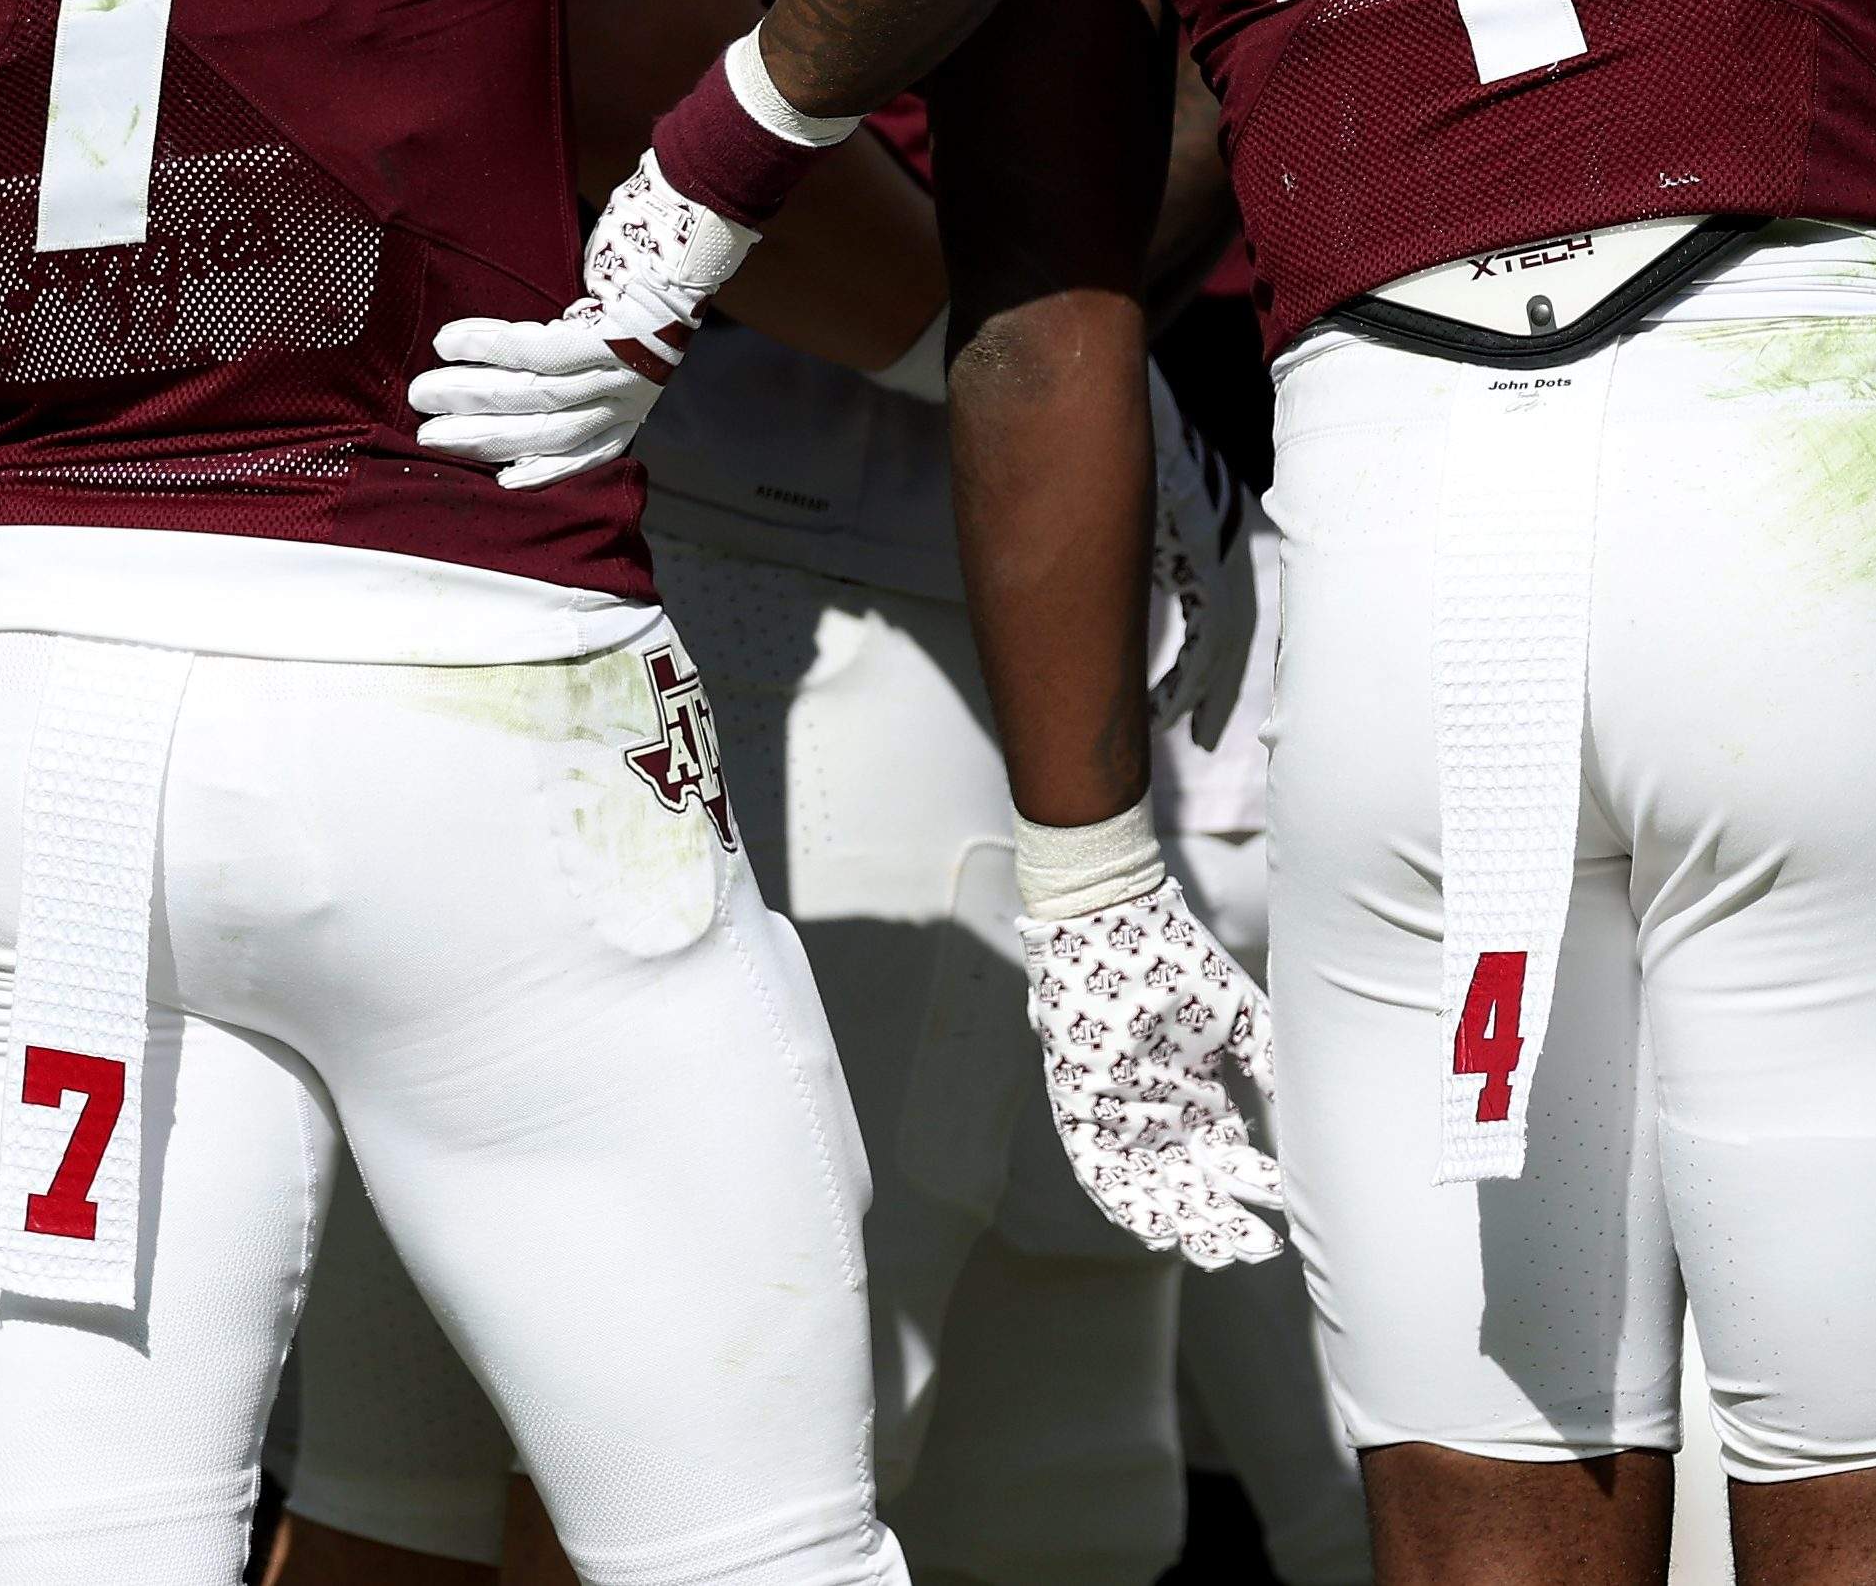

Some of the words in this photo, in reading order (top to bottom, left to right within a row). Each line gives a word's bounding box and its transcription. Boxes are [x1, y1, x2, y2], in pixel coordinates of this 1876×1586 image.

[1467, 235, 1594, 280] XTECH
[1488, 379, 1529, 392] John
[1534, 377, 1572, 390] Dots
[1453, 951, 1527, 1123] 4
[22, 1045, 125, 1241] 7
